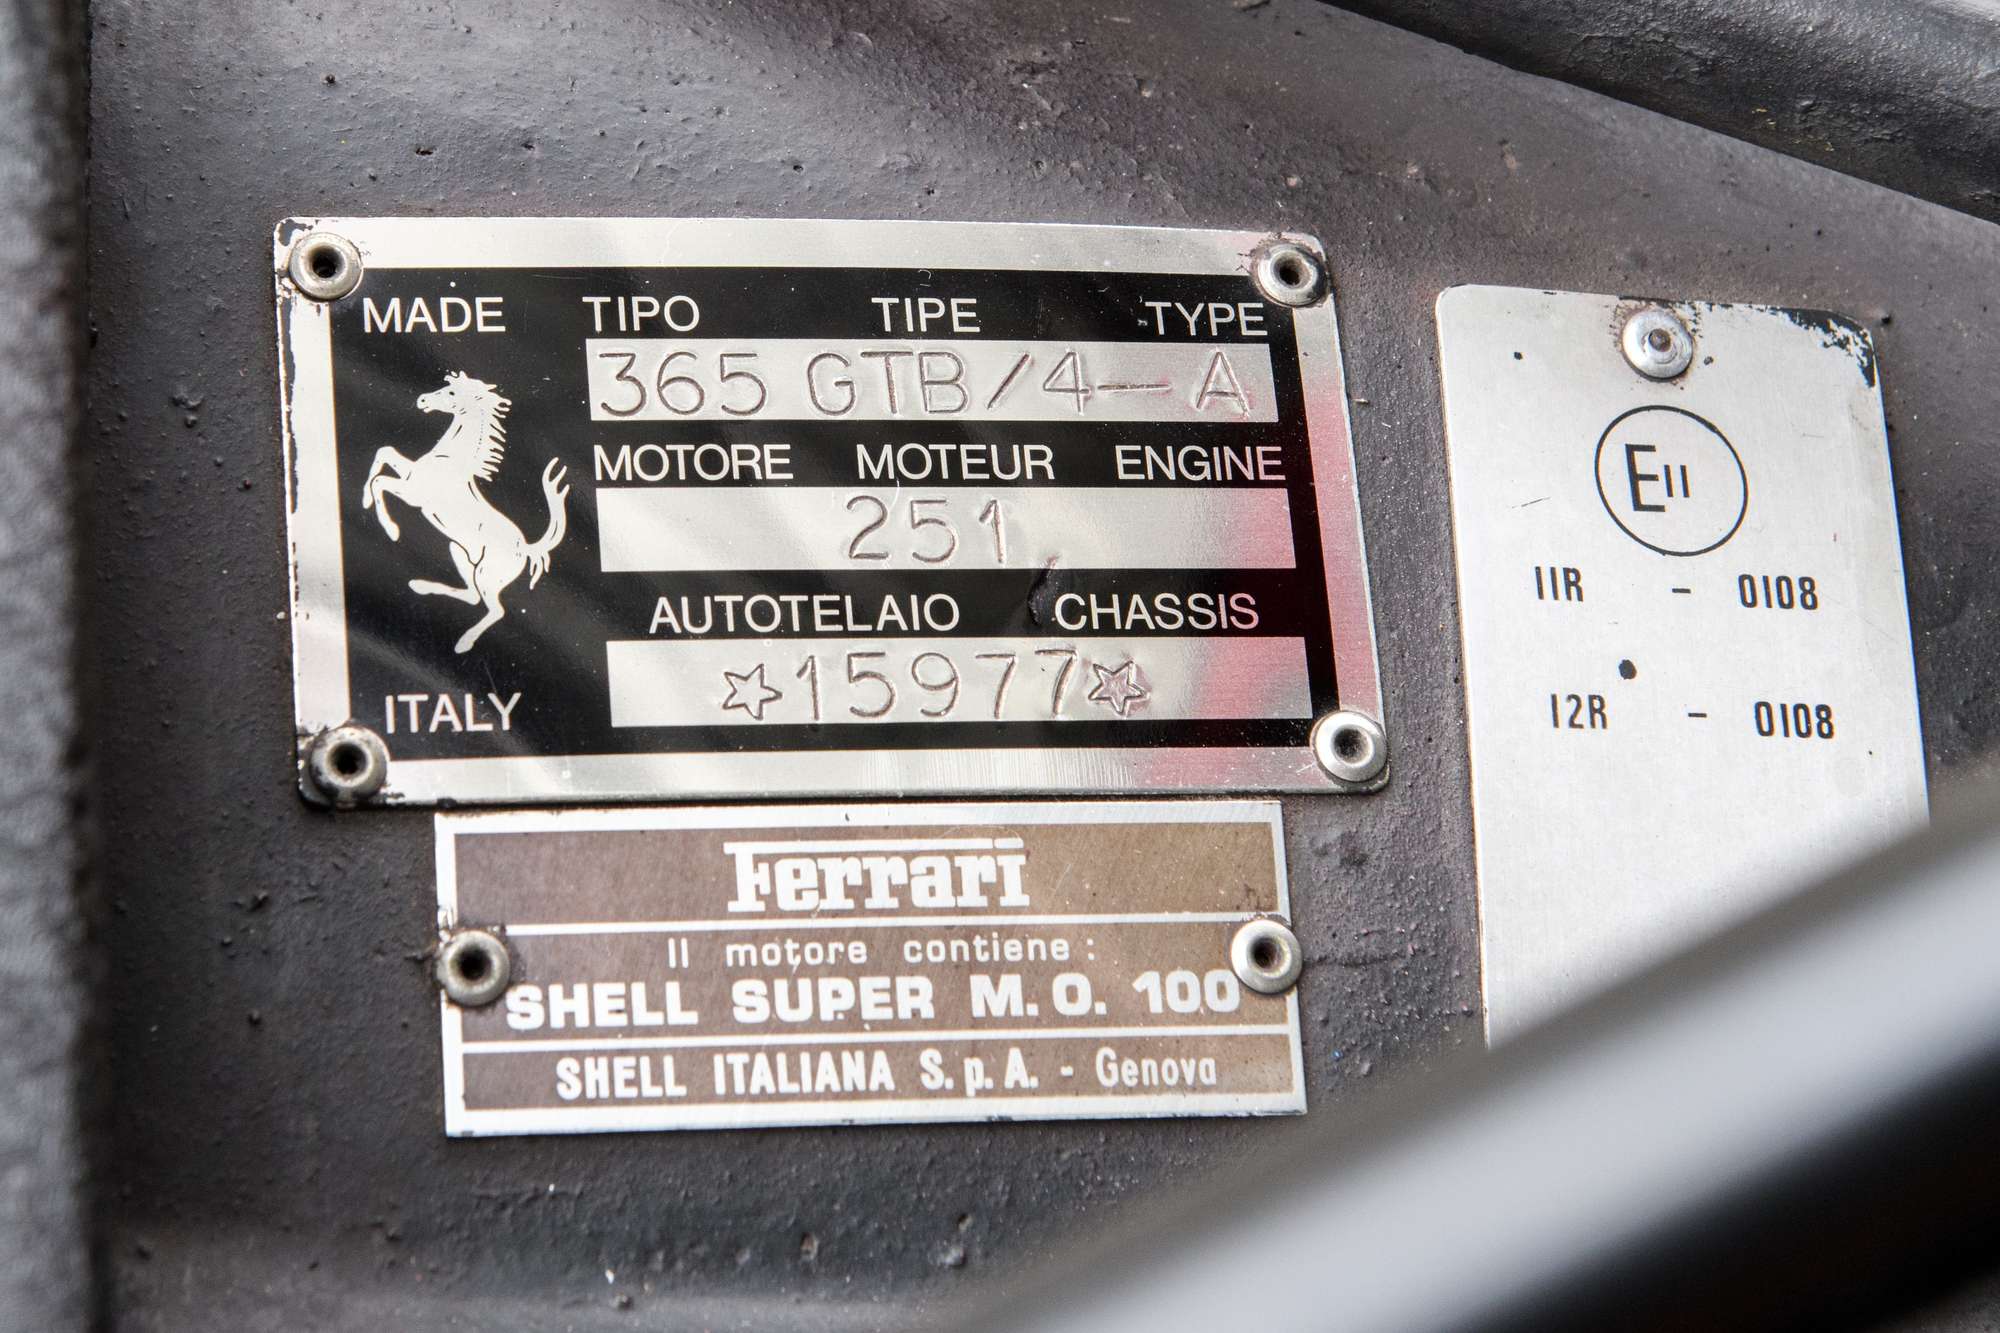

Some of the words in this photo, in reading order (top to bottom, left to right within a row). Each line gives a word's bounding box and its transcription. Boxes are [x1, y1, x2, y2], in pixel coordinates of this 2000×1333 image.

[364, 297, 506, 333] MADE
[582, 295, 700, 332] TIPO
[872, 297, 980, 333] TIPE
[1145, 302, 1268, 337] TYPE
[599, 351, 767, 418] 365
[594, 444, 793, 481] MOTORE
[857, 443, 1054, 480] MOTEUR
[1116, 445, 1286, 481] ENGINE
[847, 495, 1006, 564] 251
[649, 593, 960, 634] AUTOTELAIO
[1055, 593, 1259, 630] CHASSIS
[796, 649, 1078, 721] 15977
[385, 693, 521, 734] ITALY
[1551, 693, 1608, 730] 12R
[723, 837, 1030, 913] Ferrari
[726, 939, 867, 968] motore
[506, 981, 698, 1030] SHELL
[732, 975, 935, 1024] SUPER
[1132, 969, 1240, 1014] 100
[556, 1055, 687, 1100] SHELL
[714, 1050, 895, 1095] ITALIANA
[1096, 1047, 1217, 1088] Genova
